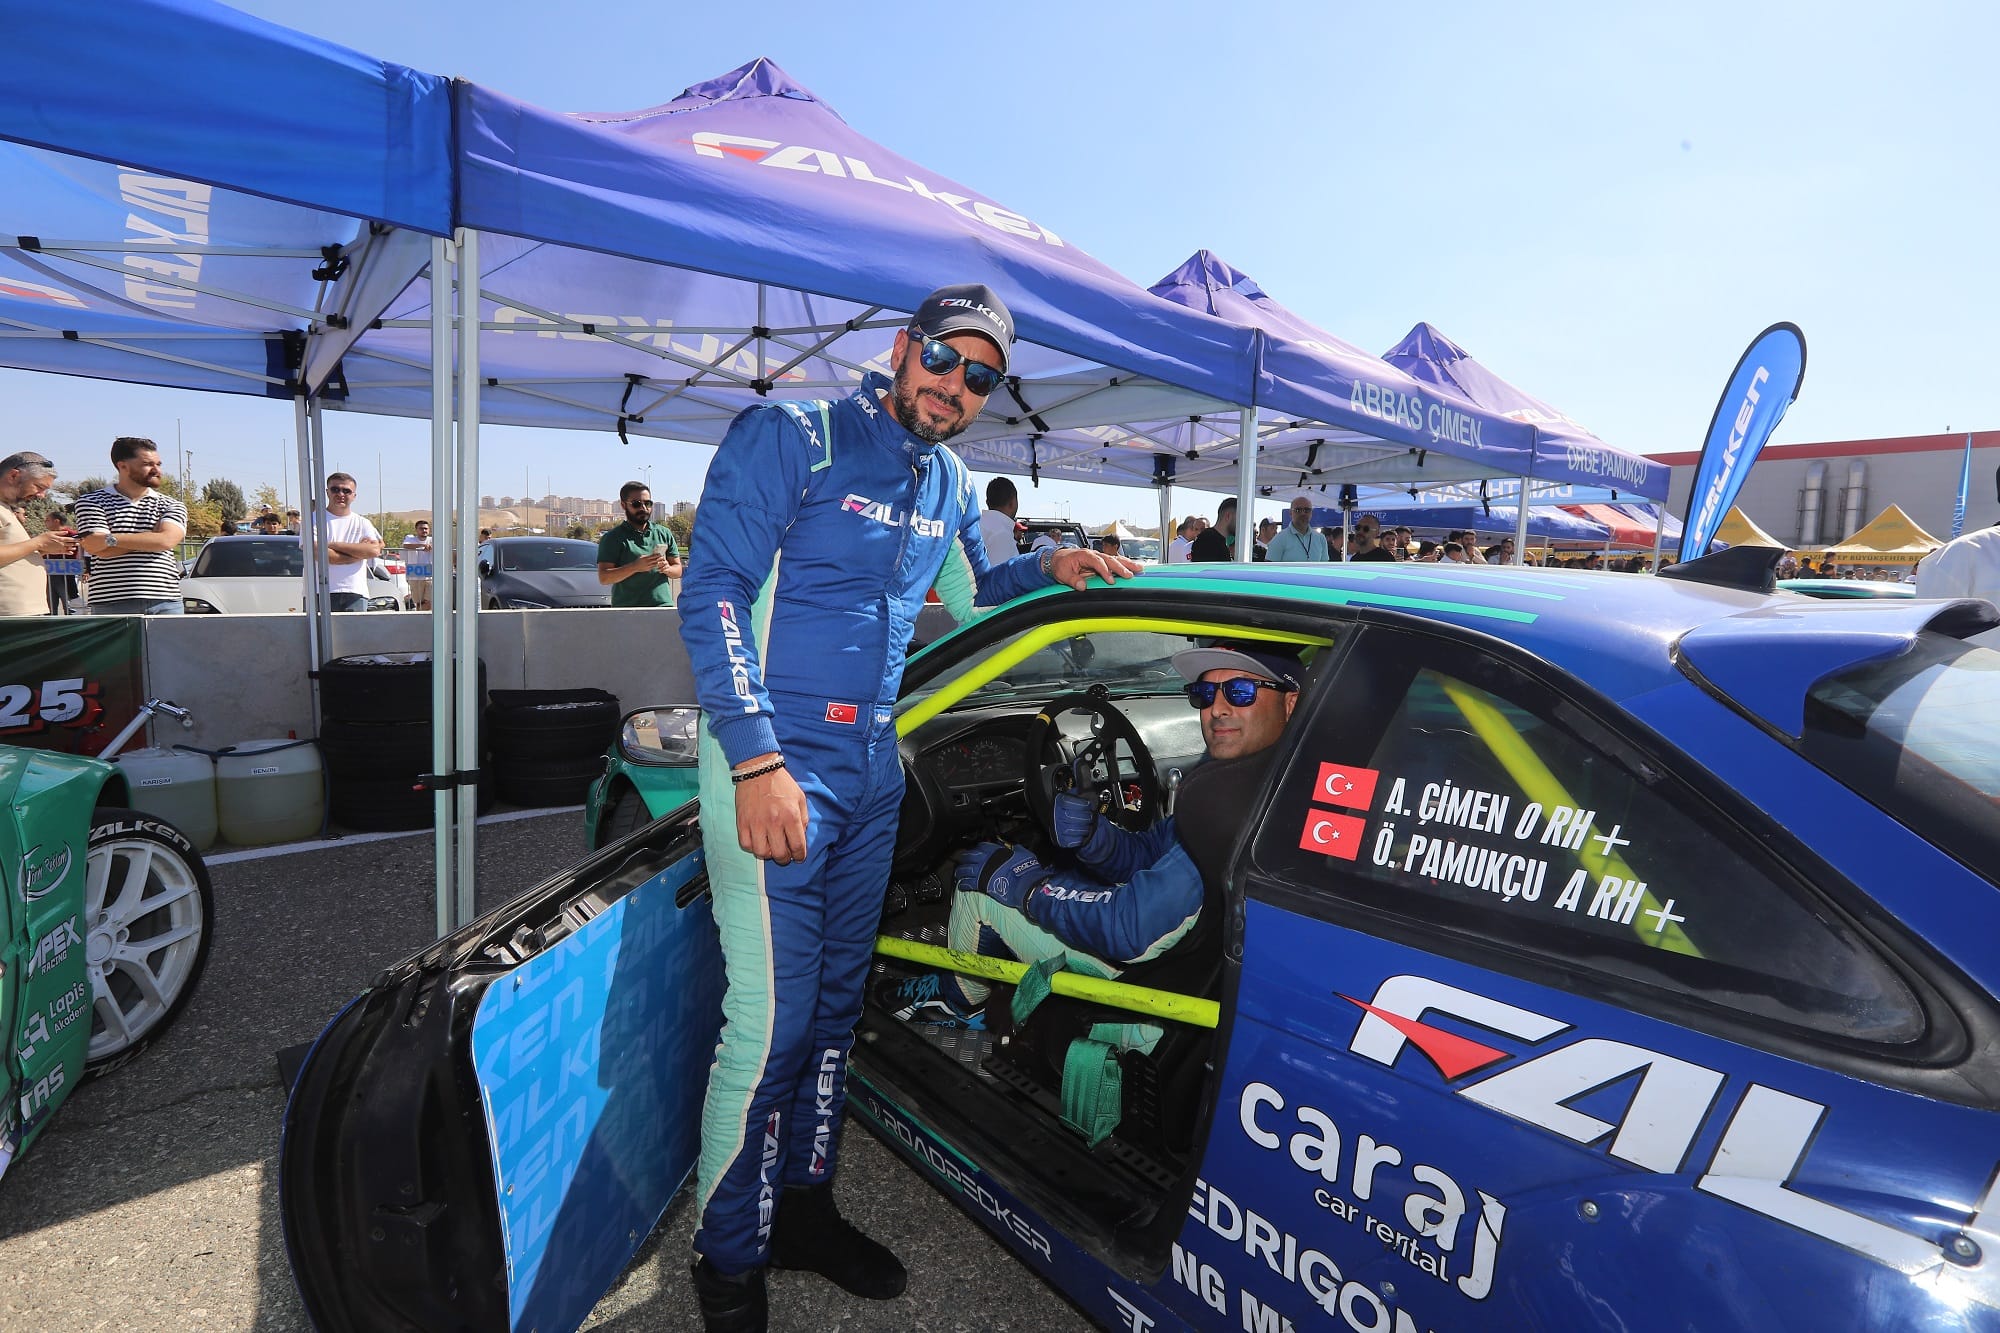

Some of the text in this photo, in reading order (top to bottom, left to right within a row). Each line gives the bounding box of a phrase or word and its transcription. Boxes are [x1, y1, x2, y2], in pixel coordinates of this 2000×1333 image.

[937, 299, 1007, 333] FALKEN
[1350, 379, 1422, 430] ABBAS
[1428, 400, 1483, 449] ÇİMEN
[1601, 453, 1648, 489] PAMUKÇU
[1693, 366, 1770, 546] FALKEN
[840, 493, 944, 538] FALKEN
[407, 565, 432, 577] POL
[717, 597, 759, 704] FALKEN
[0, 678, 84, 728] 25
[88, 820, 191, 852] ALKEN
[1384, 777, 1411, 817] A.
[1418, 779, 1510, 835] ÇİMEN
[1540, 805, 1596, 850] RH
[1372, 821, 1396, 869] Ö.
[1403, 833, 1549, 903] PAMUKÇU
[1553, 868, 1588, 912] A
[1586, 876, 1648, 925] RH
[28, 914, 82, 980] APEX
[41, 950, 68, 976] RACING
[49, 981, 85, 1019] Lapis
[809, 1048, 840, 1180] FALKEN
[1331, 974, 2000, 1312] FAL
[757, 1108, 780, 1255] FALKEN
[882, 1108, 1053, 1263] ROADPECKER
[1239, 1082, 1507, 1300] caraj
[1313, 1188, 1448, 1282] car rental
